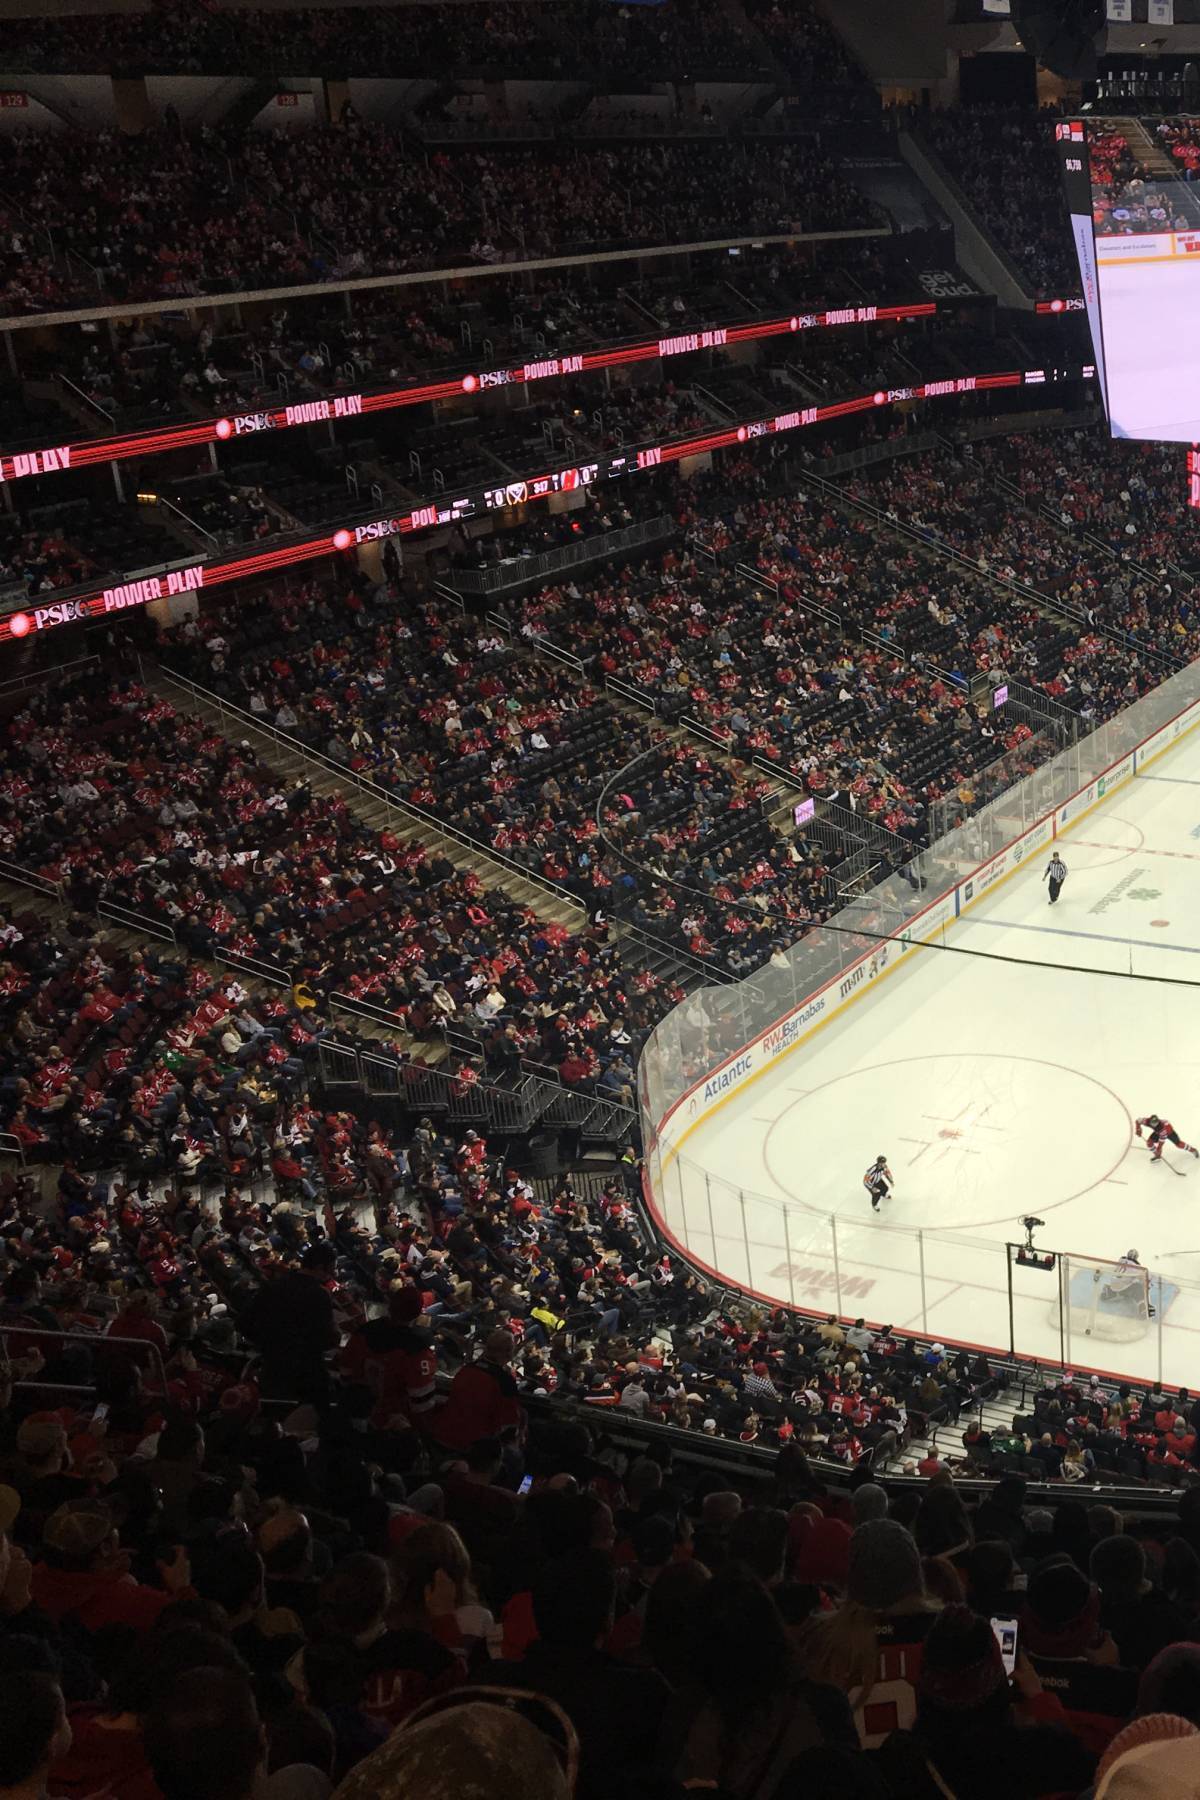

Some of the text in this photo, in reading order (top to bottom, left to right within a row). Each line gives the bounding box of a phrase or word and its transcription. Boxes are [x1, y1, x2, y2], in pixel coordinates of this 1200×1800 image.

[826, 308, 854, 325] POWER
[858, 306, 877, 321] PLAY
[659, 333, 698, 356] POWER
[524, 362, 558, 380] POWER
[562, 355, 583, 373] PLAY
[925, 380, 955, 397] POWER
[957, 377, 976, 392] PLAY
[286, 401, 331, 426] POWER
[334, 394, 362, 416] PLAY
[775, 413, 800, 431] POWER
[802, 407, 818, 425] PLAY
[103, 577, 162, 612] POWER
[167, 566, 204, 595] PLAY
[772, 1031, 800, 1056] HEALTH
[704, 1055, 753, 1102] Atlantic
